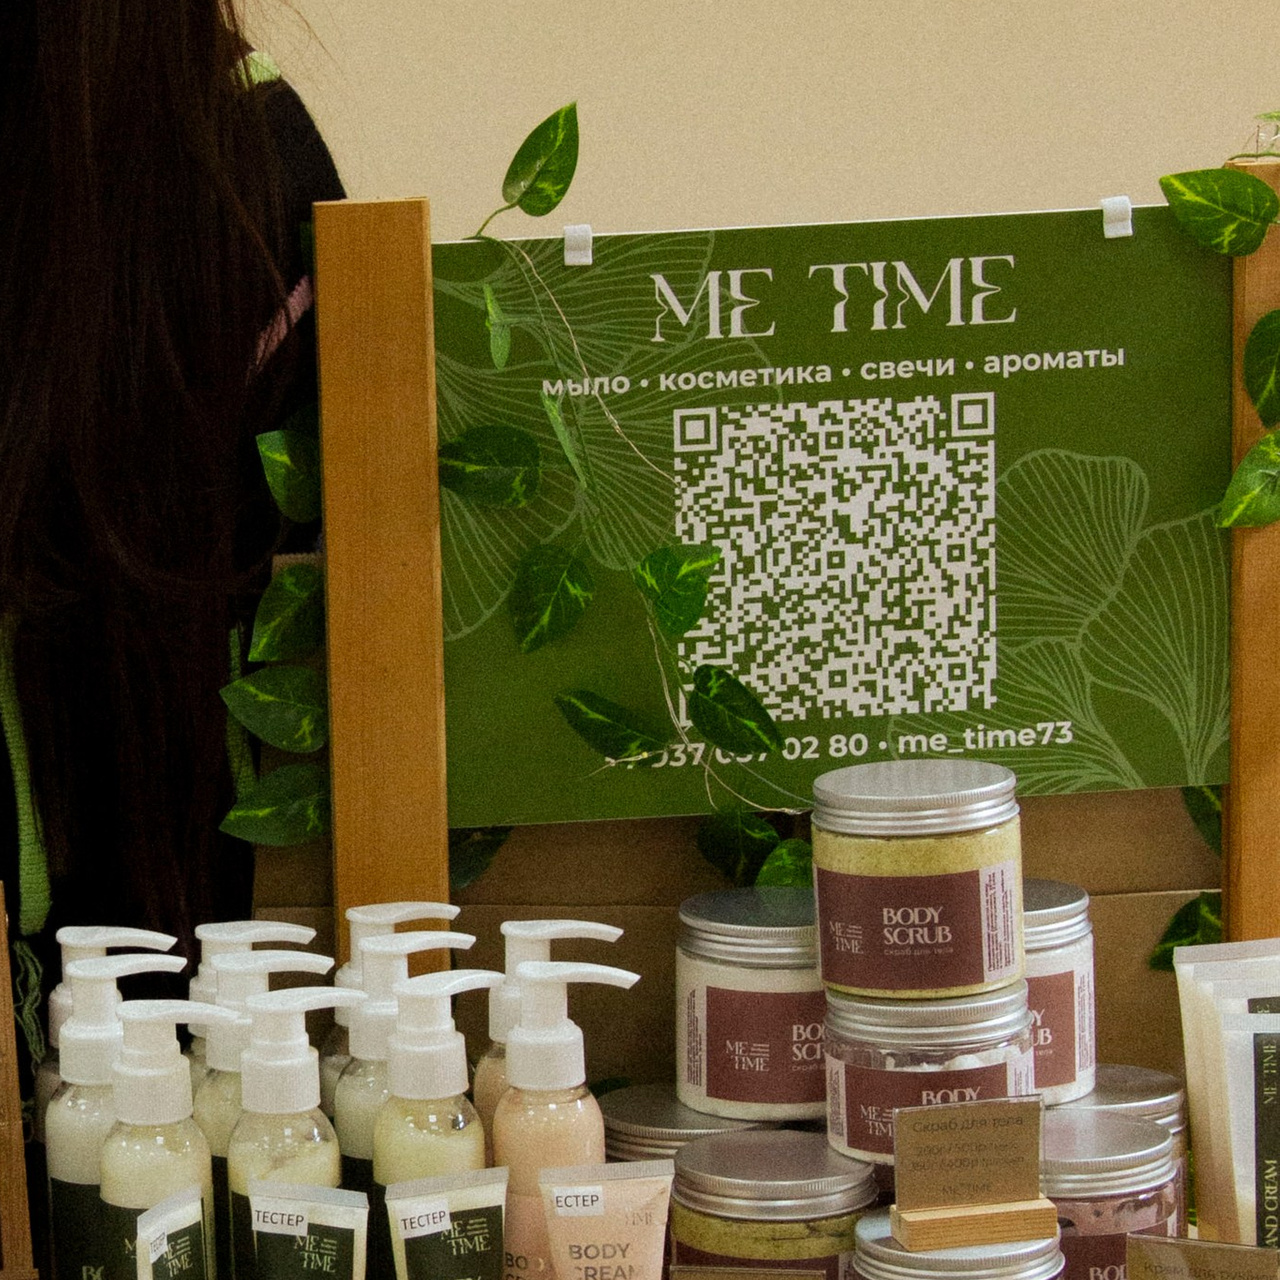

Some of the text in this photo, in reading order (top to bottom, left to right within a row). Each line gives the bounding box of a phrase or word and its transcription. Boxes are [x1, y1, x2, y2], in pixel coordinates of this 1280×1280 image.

[650, 254, 1017, 342] ME TIME
[541, 347, 1125, 398] мыло косметика свечи ароматы
[828, 731, 869, 759] 80
[898, 720, 1074, 756] me_time73
[882, 906, 943, 926] BODY
[829, 920, 848, 938] ME
[883, 926, 953, 946] SCRUB
[833, 936, 865, 955] TIME
[792, 1022, 824, 1042] BO
[725, 1039, 750, 1056] ME
[731, 1055, 770, 1071] TIME
[860, 1104, 882, 1120] ME
[864, 1119, 893, 1137] TIM
[1264, 1160, 1279, 1249] AND CREAM
[255, 1209, 305, 1227] ТЕСТЕР
[401, 1210, 447, 1231] ТЕСТЕР
[293, 1235, 320, 1252] ME
[447, 1234, 491, 1256] TIME
[569, 1242, 631, 1261] BODY
[299, 1251, 337, 1273] TIME
